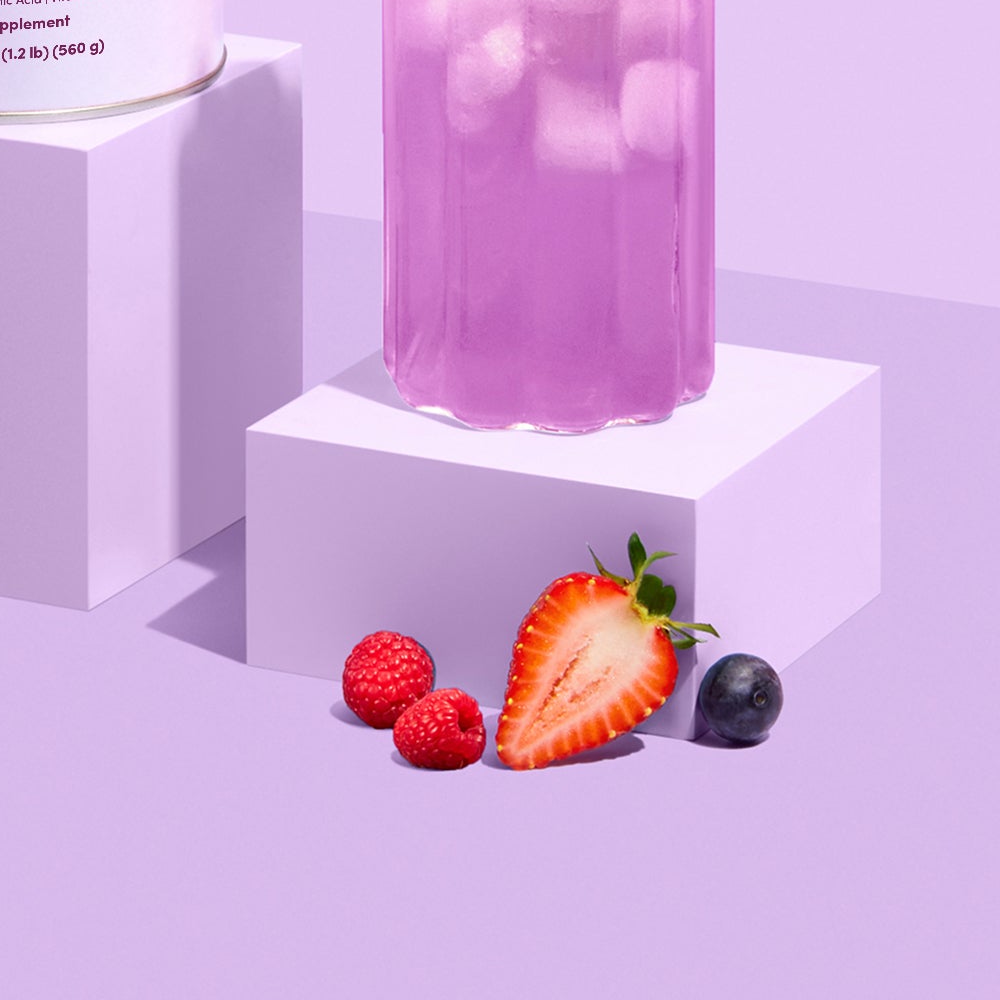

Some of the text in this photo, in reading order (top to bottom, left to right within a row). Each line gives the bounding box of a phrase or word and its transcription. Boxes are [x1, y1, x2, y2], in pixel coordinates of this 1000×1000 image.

[1, 47, 26, 63] (1.2
[29, 46, 49, 62] lb)
[52, 42, 86, 60] (560
[90, 38, 105, 56] g)
